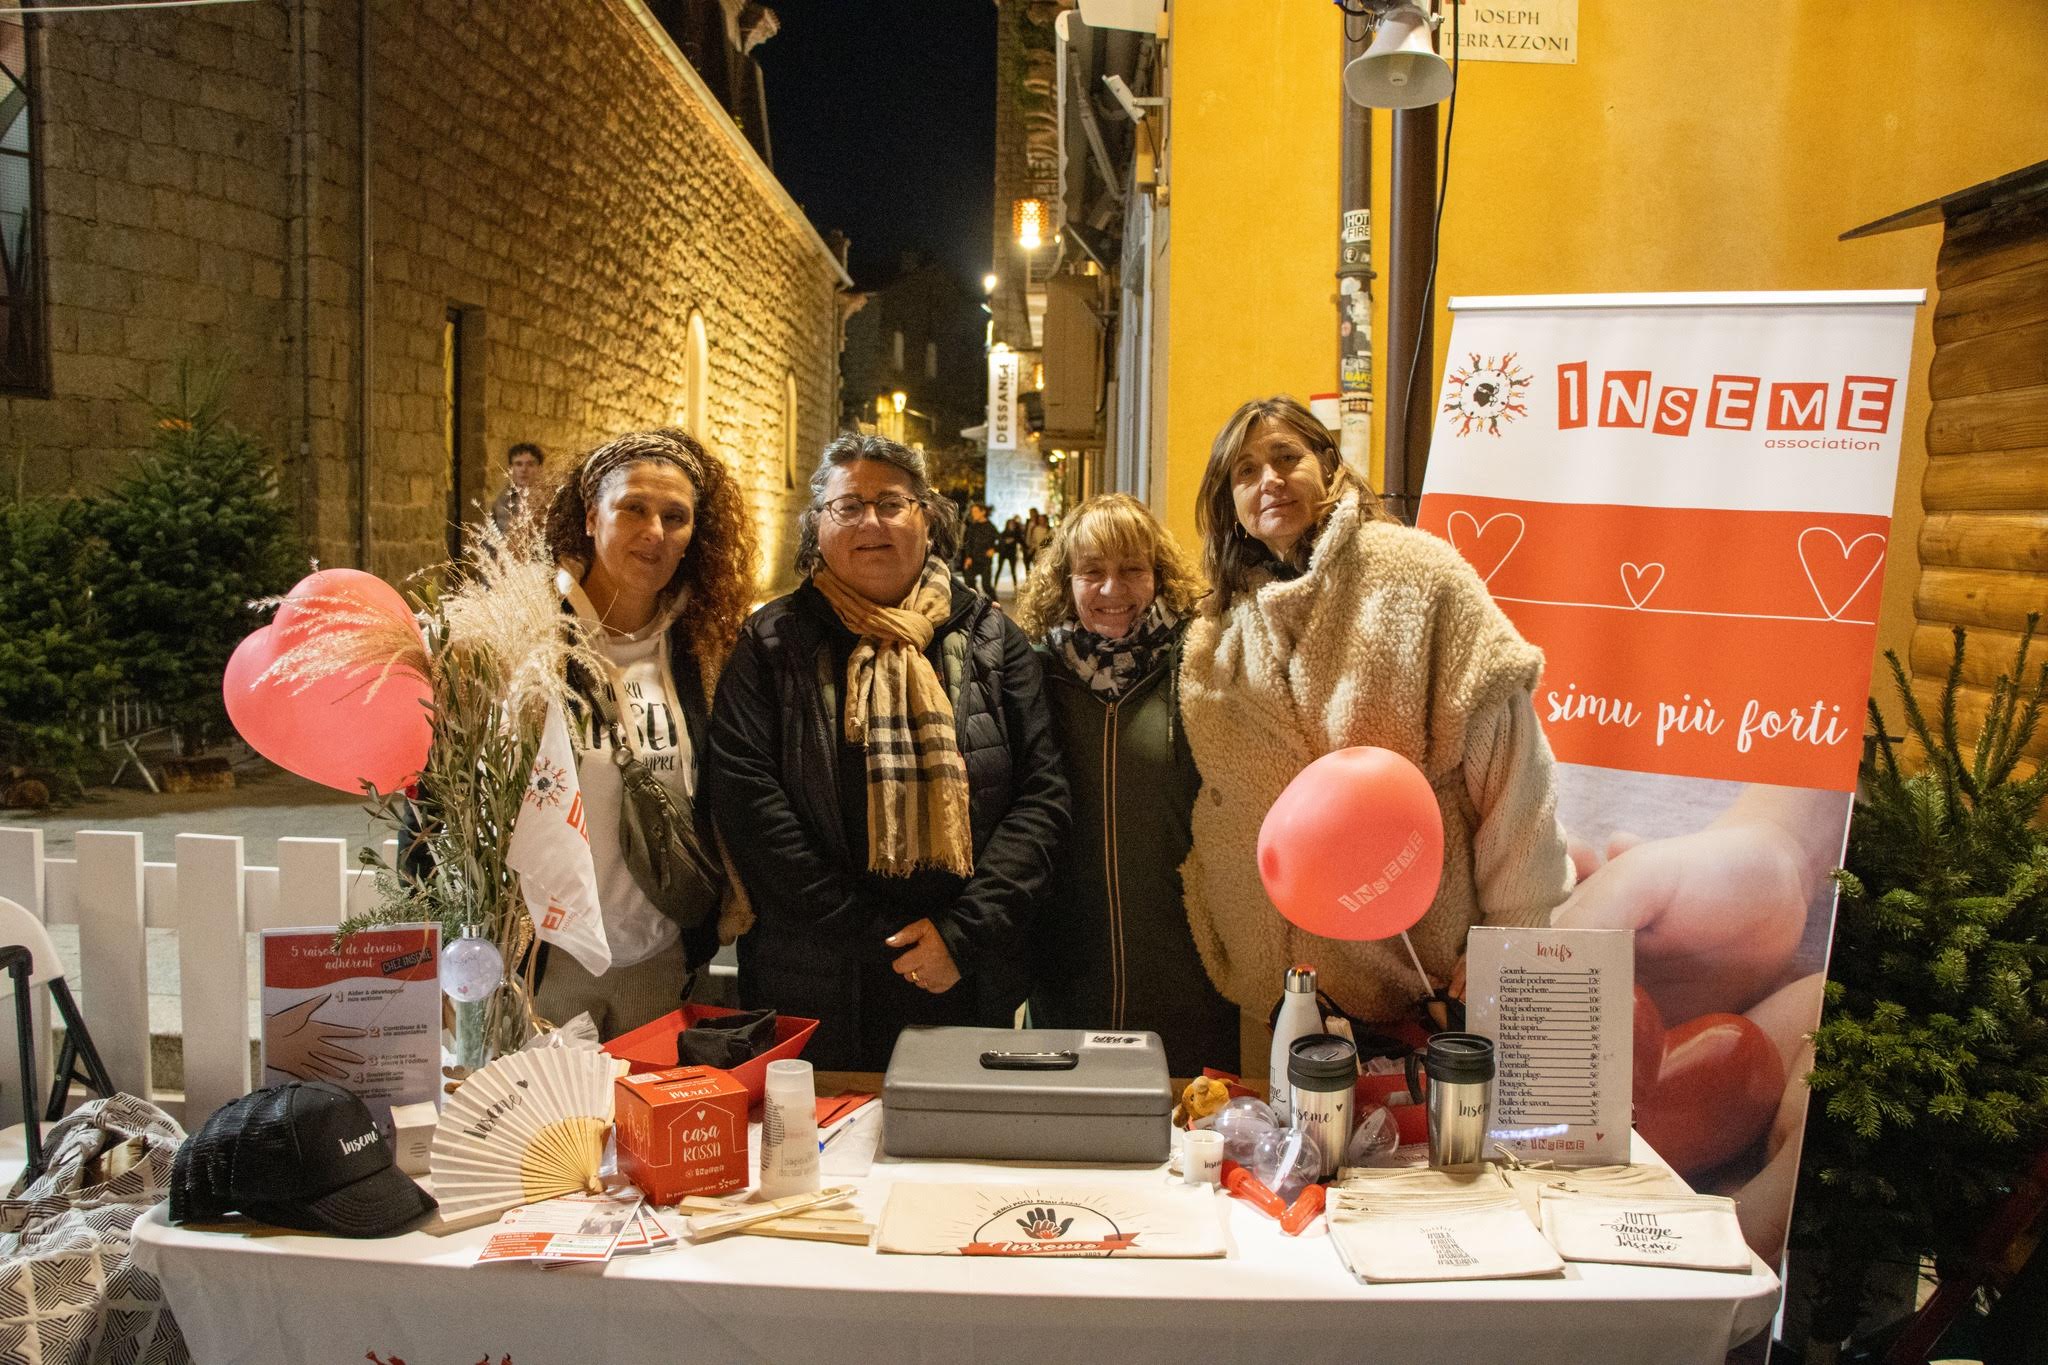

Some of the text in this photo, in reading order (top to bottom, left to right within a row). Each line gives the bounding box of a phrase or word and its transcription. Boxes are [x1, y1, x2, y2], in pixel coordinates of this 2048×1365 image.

[1475, 9, 1539, 25] JOSEPH
[1445, 32, 1568, 51] TERRAZZONI
[1558, 362, 1896, 435] INSEME
[1764, 437, 1880, 451] association
[1547, 683, 1848, 753] simu più forti
[291, 945, 299, 957] 5
[345, 943, 358, 954] de
[363, 943, 402, 953] devenir
[1536, 941, 1572, 962] Tarifs
[1500, 967, 1527, 975] Gourde
[1500, 976, 1600, 986] Grande pochette 12€
[1520, 986, 1549, 996] pochette
[1588, 986, 1600, 994] 10€
[1500, 995, 1533, 1004] Casquette
[1500, 1004, 1516, 1015] Mug
[1526, 1014, 1546, 1024] neige
[368, 1026, 380, 1038] 2
[1520, 1024, 1538, 1034] sapin
[353, 1072, 364, 1084] 4
[1522, 1070, 1540, 1080] plage
[1499, 1080, 1526, 1089] Bougies
[669, 1087, 712, 1099] Merci
[1499, 1088, 1517, 1096] Porte
[1498, 1108, 1526, 1116] Gobelet
[1498, 1117, 1516, 1126] Stylo
[682, 1125, 720, 1143] casa
[1624, 1212, 1658, 1226] TUTTI
